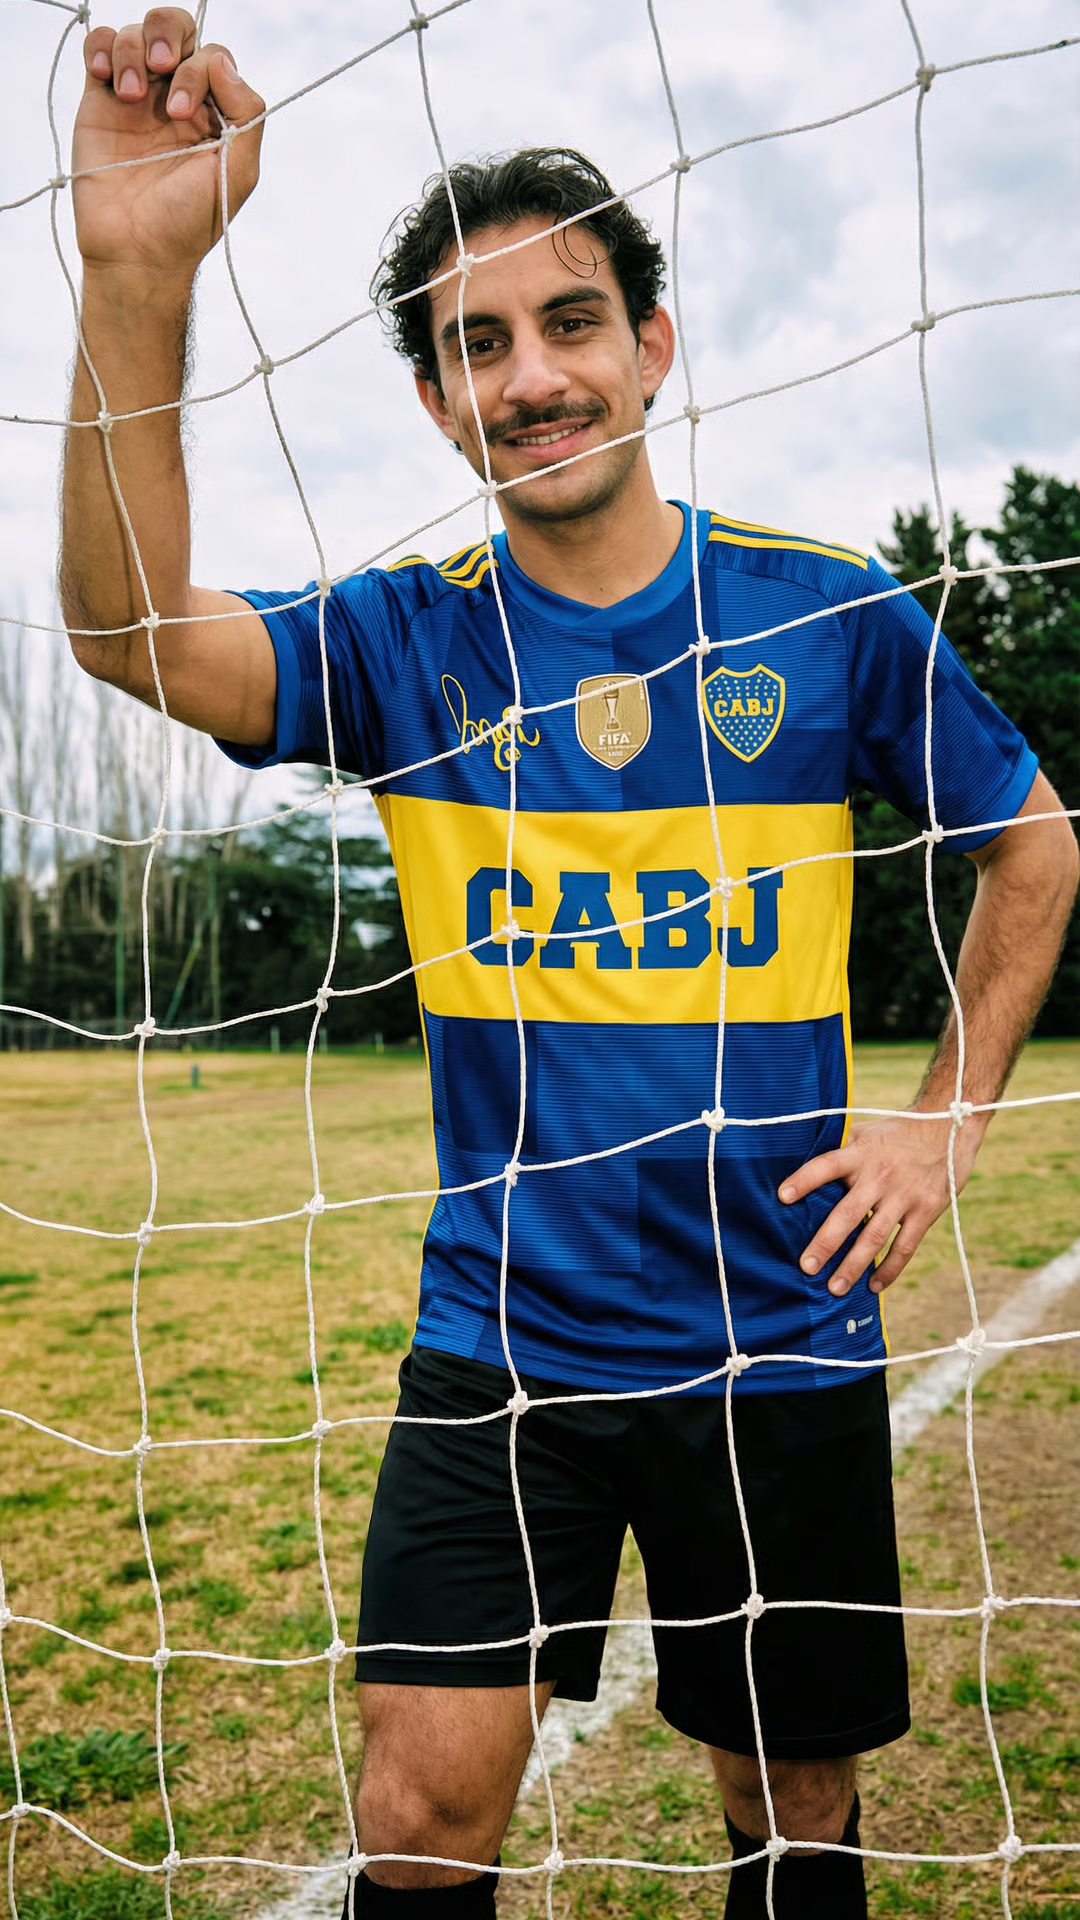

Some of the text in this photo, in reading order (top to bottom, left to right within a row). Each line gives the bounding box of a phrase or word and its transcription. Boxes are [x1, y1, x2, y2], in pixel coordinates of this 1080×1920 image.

[714, 699, 774, 717] CABJ
[599, 733, 630, 746] FIFA
[466, 866, 784, 970] CABJ
